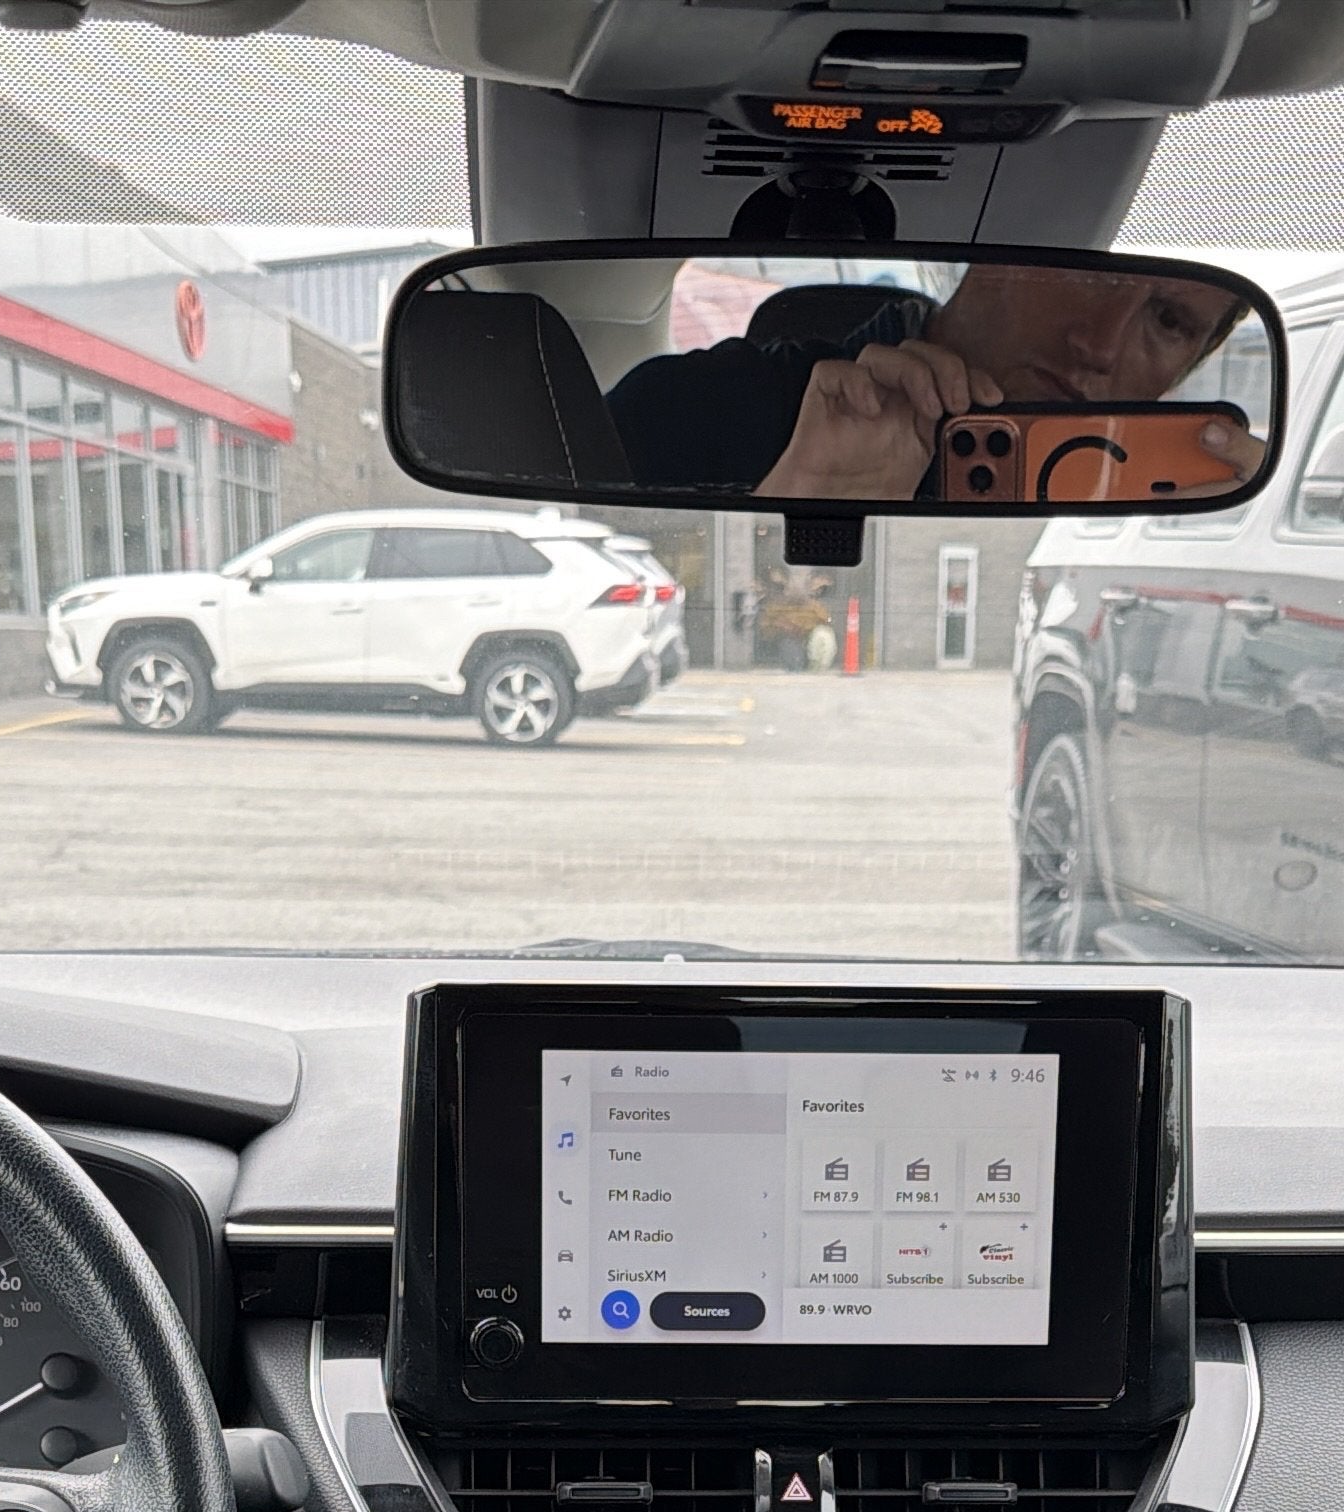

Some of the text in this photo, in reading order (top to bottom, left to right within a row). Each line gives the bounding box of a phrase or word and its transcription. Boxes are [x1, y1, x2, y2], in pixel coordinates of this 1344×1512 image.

[772, 103, 863, 120] PASSENGER
[785, 118, 847, 130] AIR BAG
[876, 119, 909, 132] OFF
[634, 1066, 670, 1078] Radio
[1010, 1068, 1045, 1083] 9:46
[802, 1099, 865, 1113] Favorites
[608, 1107, 671, 1121] Favorites
[608, 1148, 642, 1162] Tune
[608, 1188, 672, 1202] FM Radio
[813, 1191, 859, 1202] FM 87.9
[895, 1191, 939, 1203] FM 98.1
[976, 1191, 1021, 1203] AM 530
[607, 1229, 674, 1243] AM Radio
[606, 1269, 667, 1282] SiriusXM
[809, 1273, 859, 1284] AM 1000
[886, 1273, 944, 1285] Subscribe
[967, 1273, 1025, 1285] Subscribe
[0, 1277, 22, 1291] 60
[476, 1288, 498, 1299] VOL
[20, 1302, 42, 1312] 100
[684, 1305, 730, 1317] Sources
[799, 1304, 872, 1315] 89.9 WRVO
[3, 1318, 19, 1328] 80
